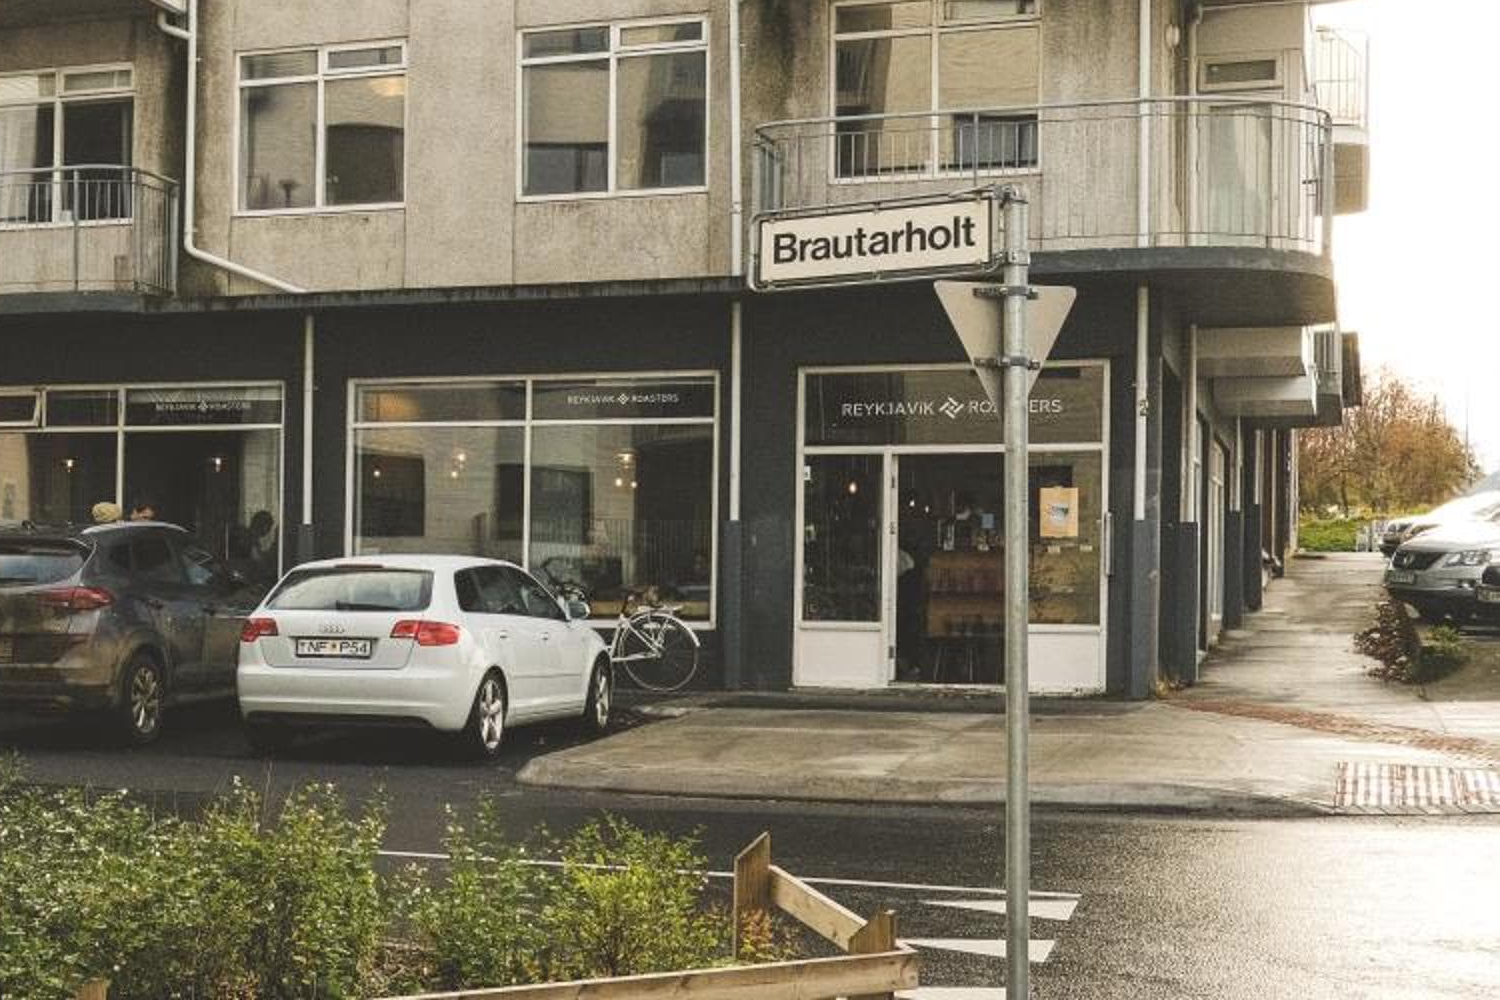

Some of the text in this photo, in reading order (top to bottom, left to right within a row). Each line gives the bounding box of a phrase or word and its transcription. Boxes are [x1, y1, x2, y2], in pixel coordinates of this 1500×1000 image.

[773, 215, 976, 265] Brautarholt
[841, 399, 1063, 417] REYKJAVIK ROERS
